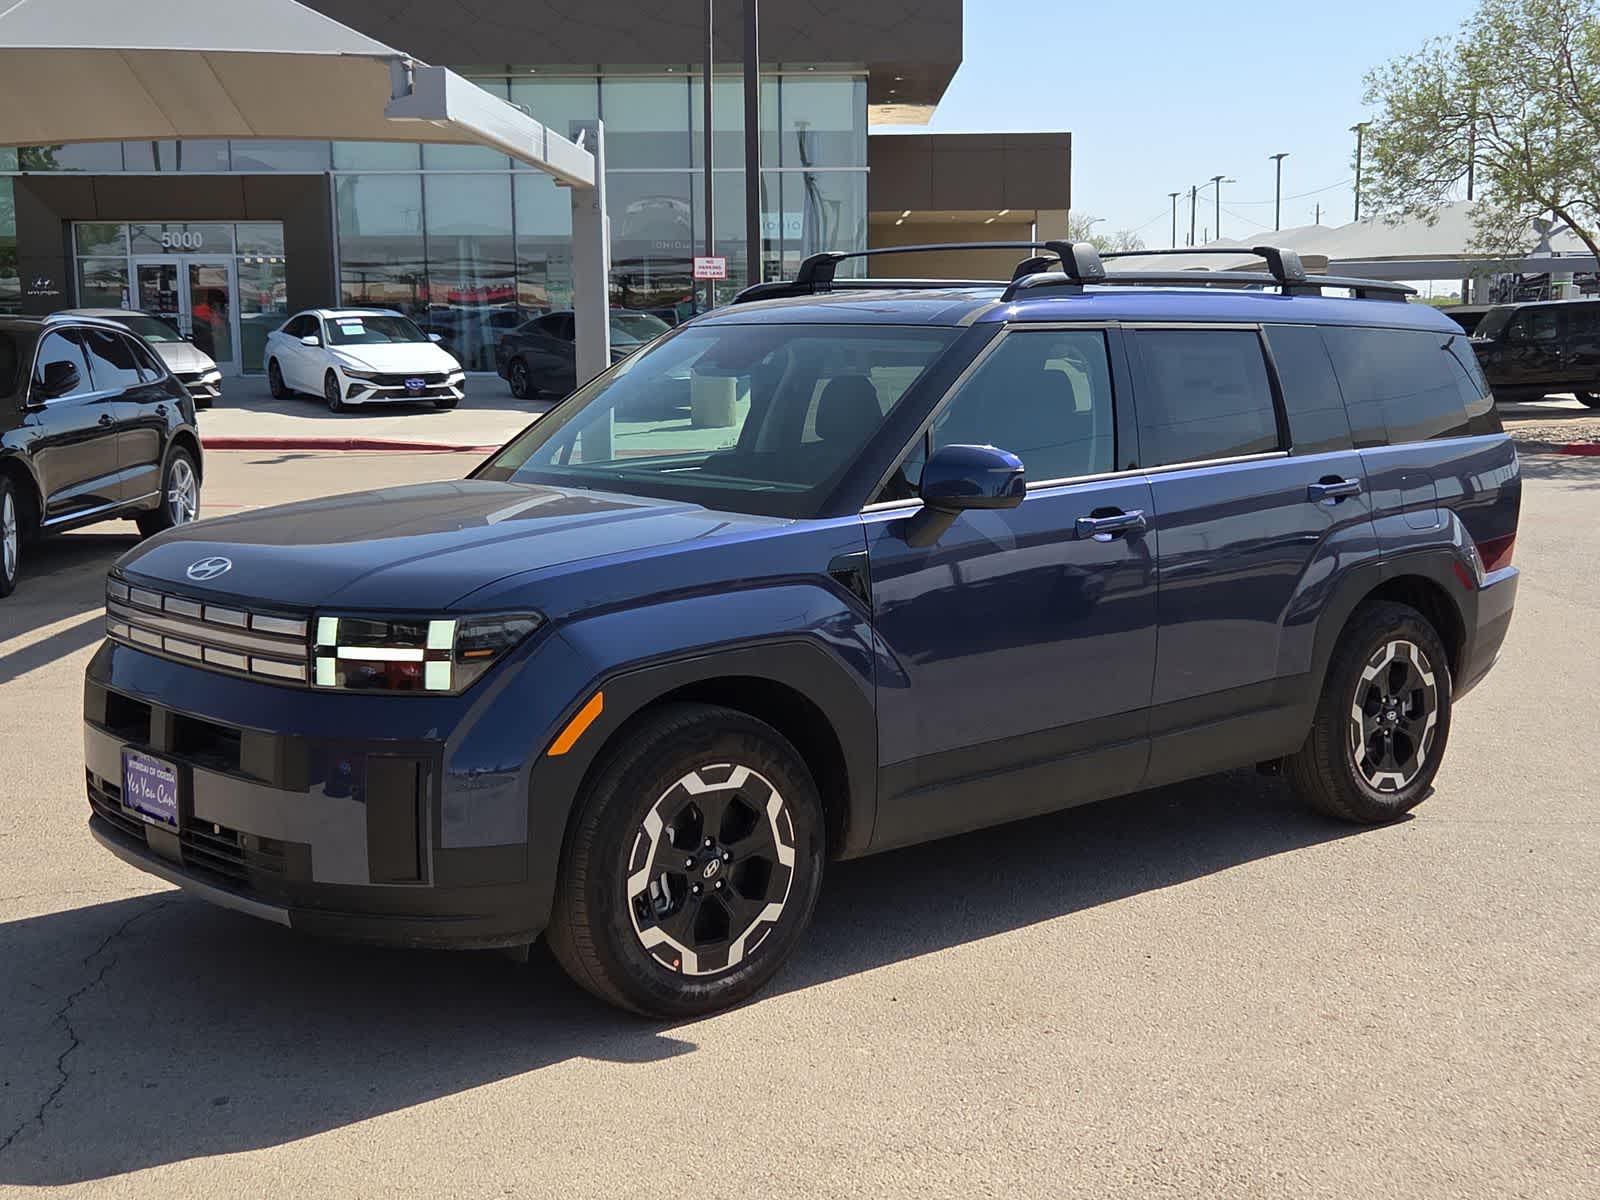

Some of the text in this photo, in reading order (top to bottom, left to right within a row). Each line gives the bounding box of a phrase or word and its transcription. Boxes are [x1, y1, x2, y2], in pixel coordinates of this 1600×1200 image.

[161, 231, 203, 248] 5000
[127, 772, 177, 808] Yes You Can!
